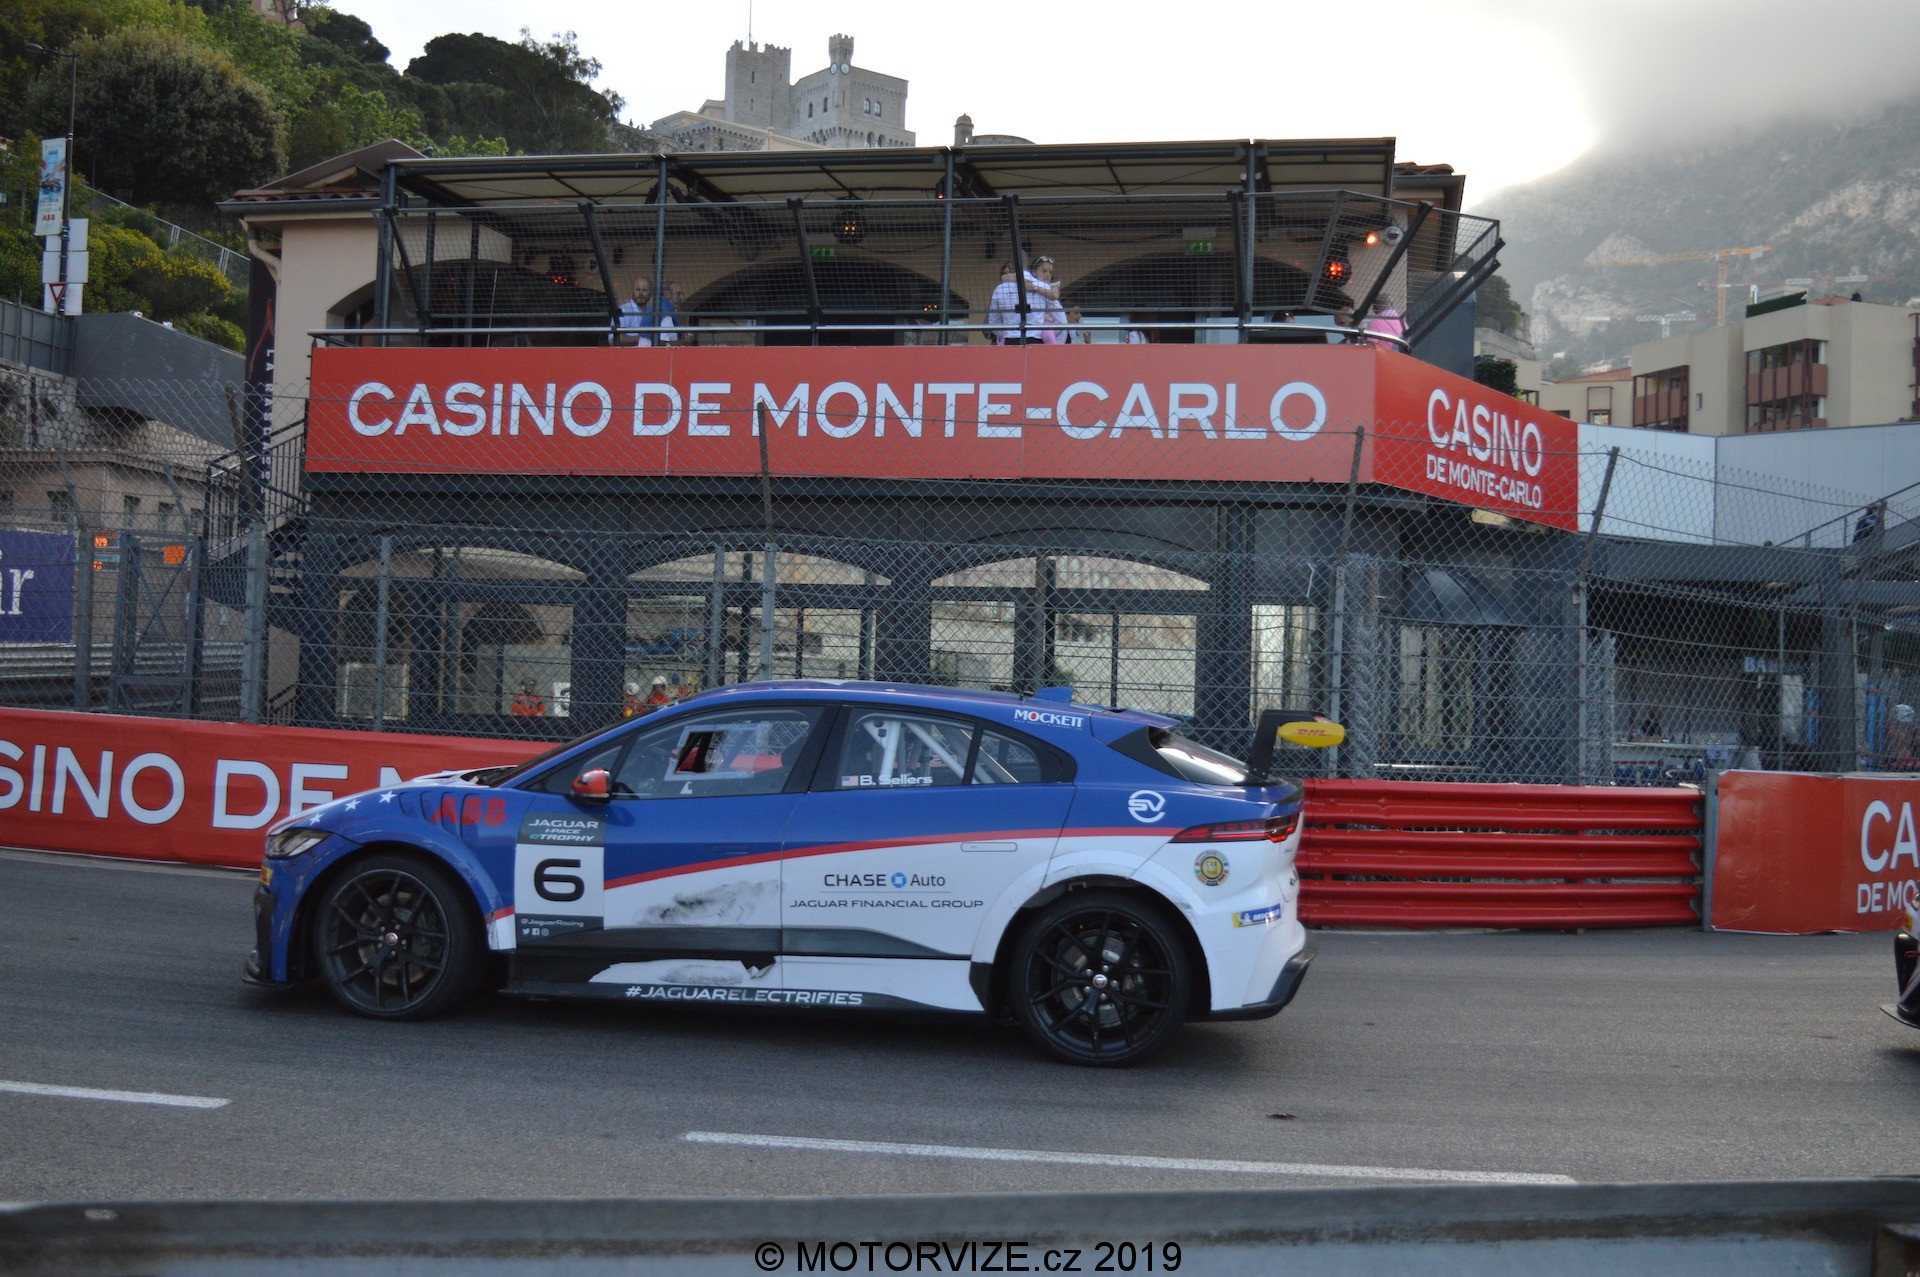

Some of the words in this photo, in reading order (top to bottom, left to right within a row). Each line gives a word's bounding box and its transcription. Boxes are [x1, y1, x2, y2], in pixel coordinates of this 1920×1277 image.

[266, 349, 275, 371] LA
[348, 382, 613, 437] CASINO
[633, 382, 732, 437] DE
[751, 382, 1327, 441] MONTE-CARLO
[1428, 388, 1542, 477] CASINO
[1426, 454, 1447, 483] DE
[1449, 460, 1542, 508] MONTE-CARLO
[1014, 709, 1084, 727] MOCKETT
[860, 775, 876, 785] B.
[878, 773, 932, 785] Sellers
[213, 759, 348, 829] DE
[432, 796, 507, 826] ABB
[529, 819, 598, 829] JAGUAR
[534, 858, 585, 902] 6
[824, 874, 887, 887] CHASE
[910, 874, 946, 887] Auto
[790, 900, 848, 908] JAGUAR
[852, 900, 928, 908] FINANCIAL
[931, 900, 984, 908] GROUP
[1857, 882, 1884, 913] DE
[521, 918, 584, 928] @JaguarRacing
[625, 985, 863, 1005] #JAGUARELECTRIFIES
